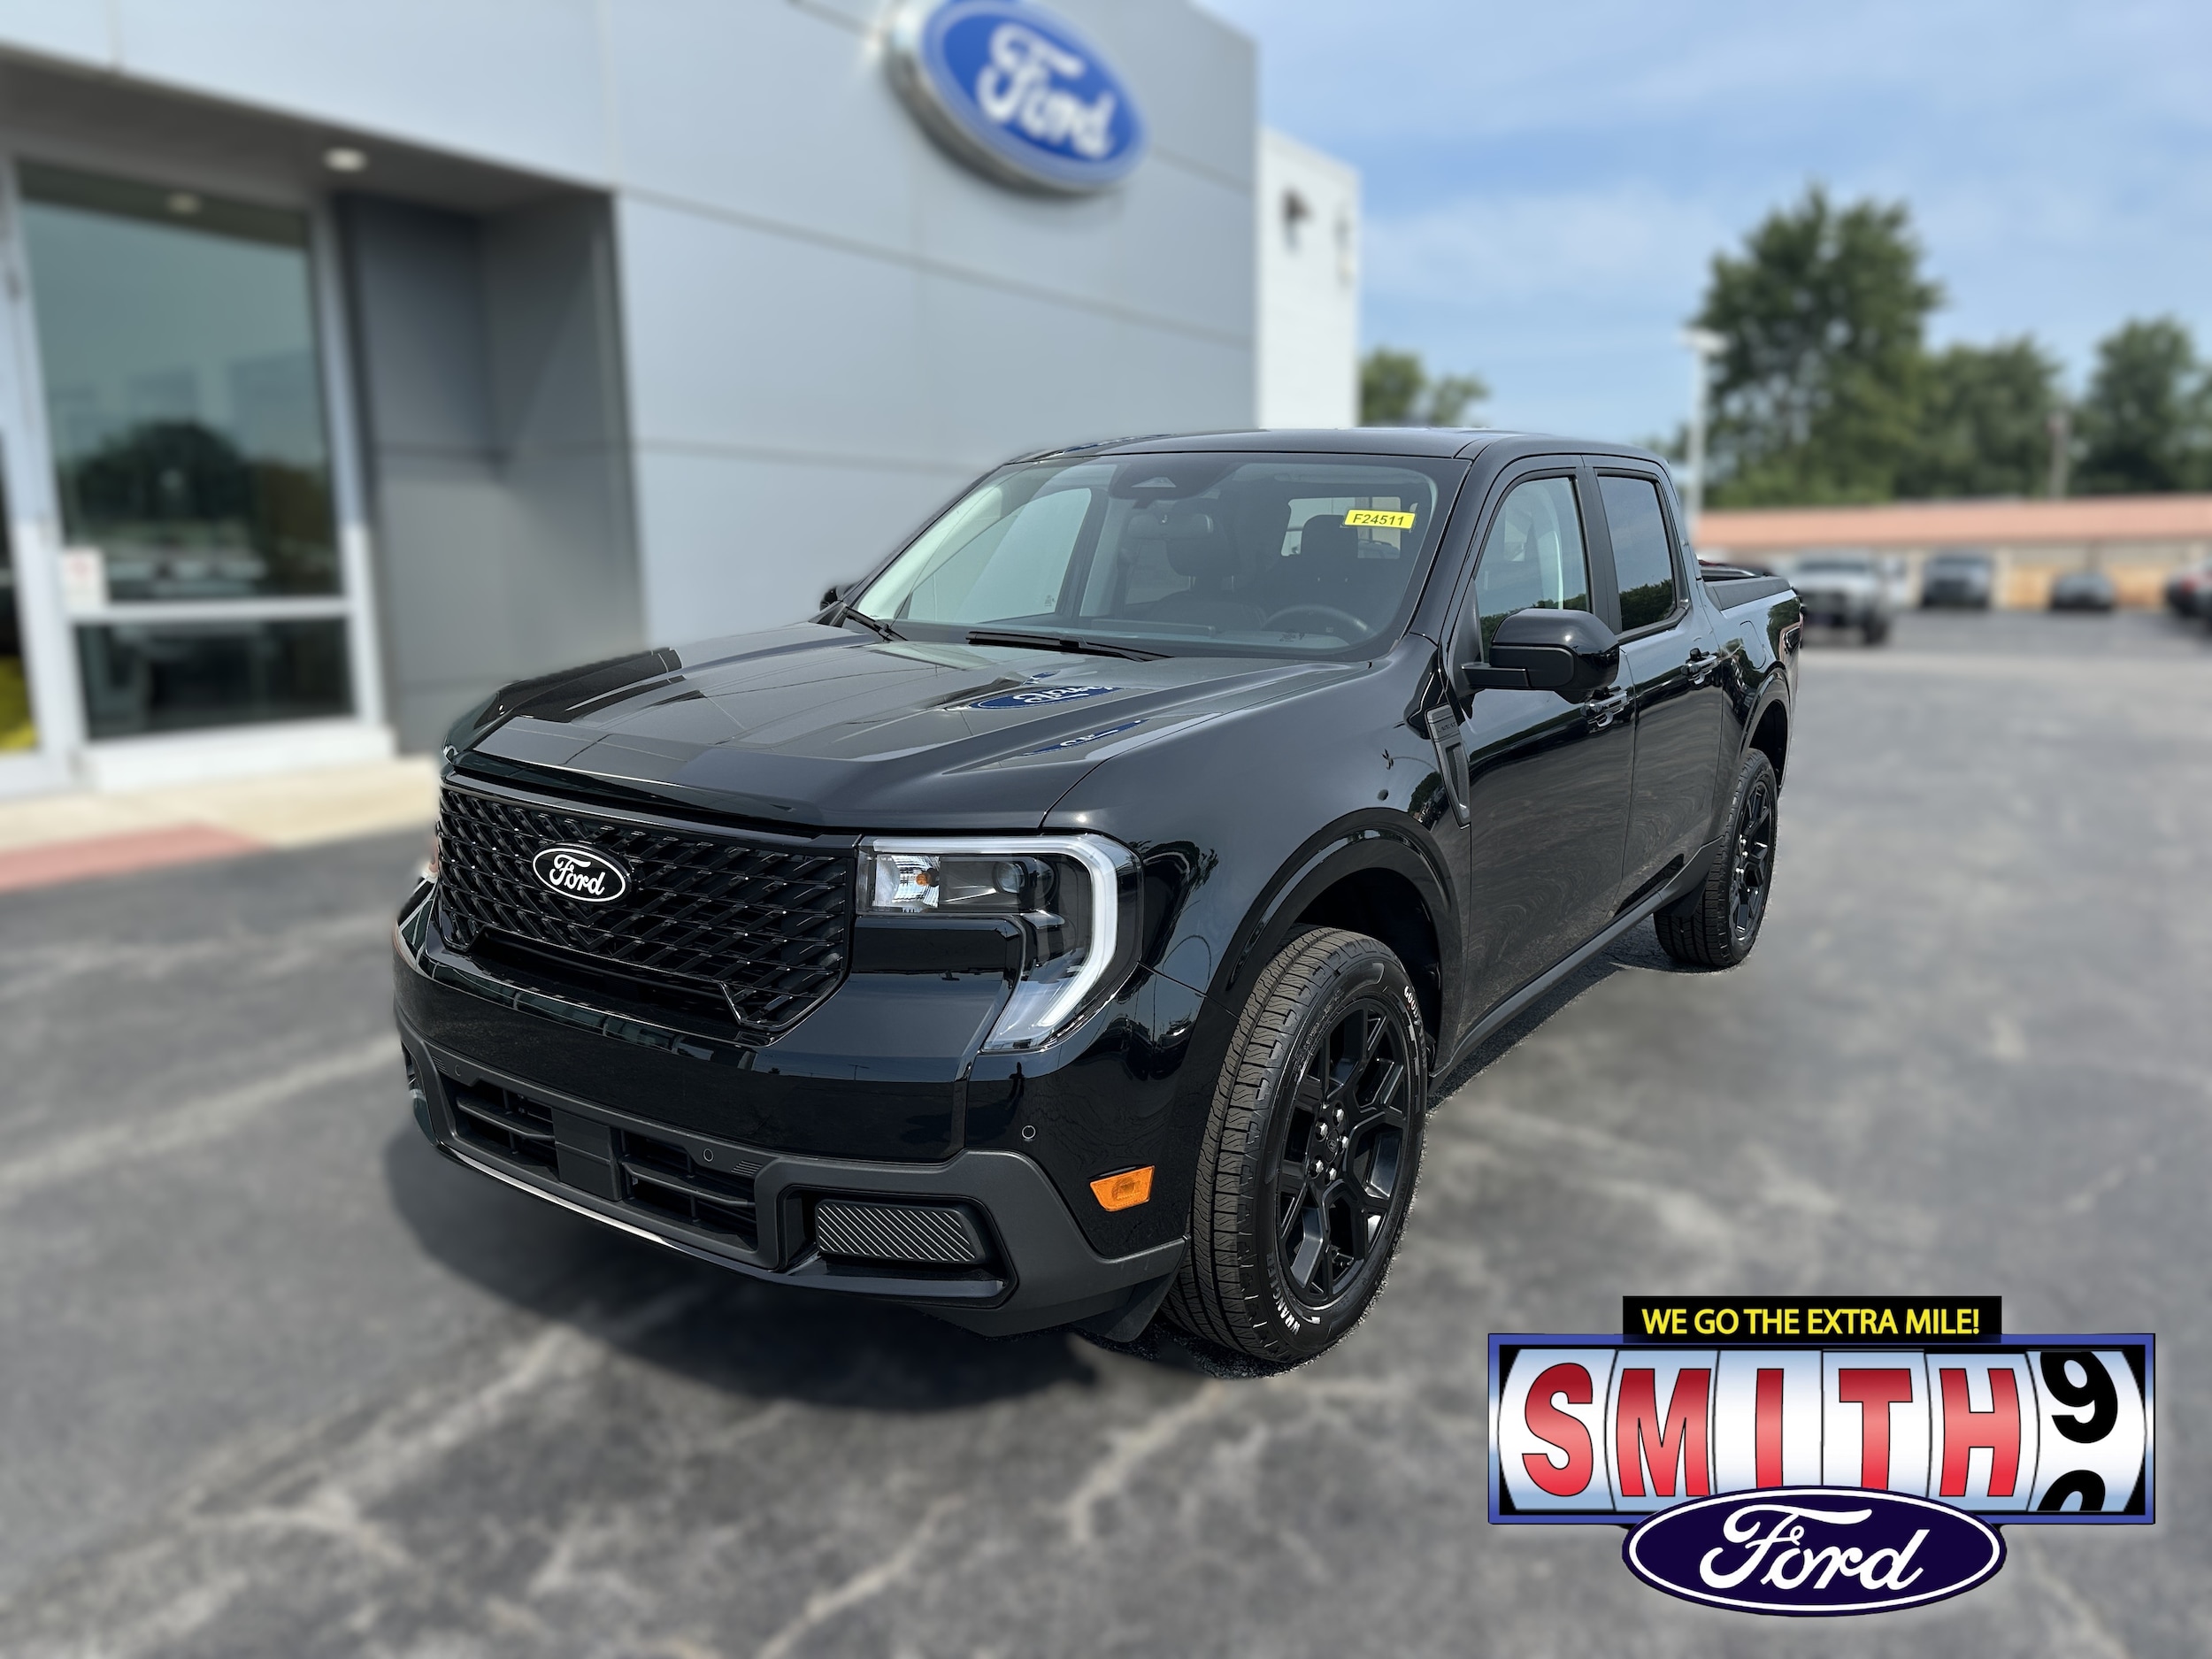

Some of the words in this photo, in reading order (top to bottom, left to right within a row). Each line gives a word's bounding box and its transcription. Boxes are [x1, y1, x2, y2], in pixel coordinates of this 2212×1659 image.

[977, 22, 1117, 158] Ford
[1353, 513, 1404, 526] F24511
[549, 854, 606, 895] Ford
